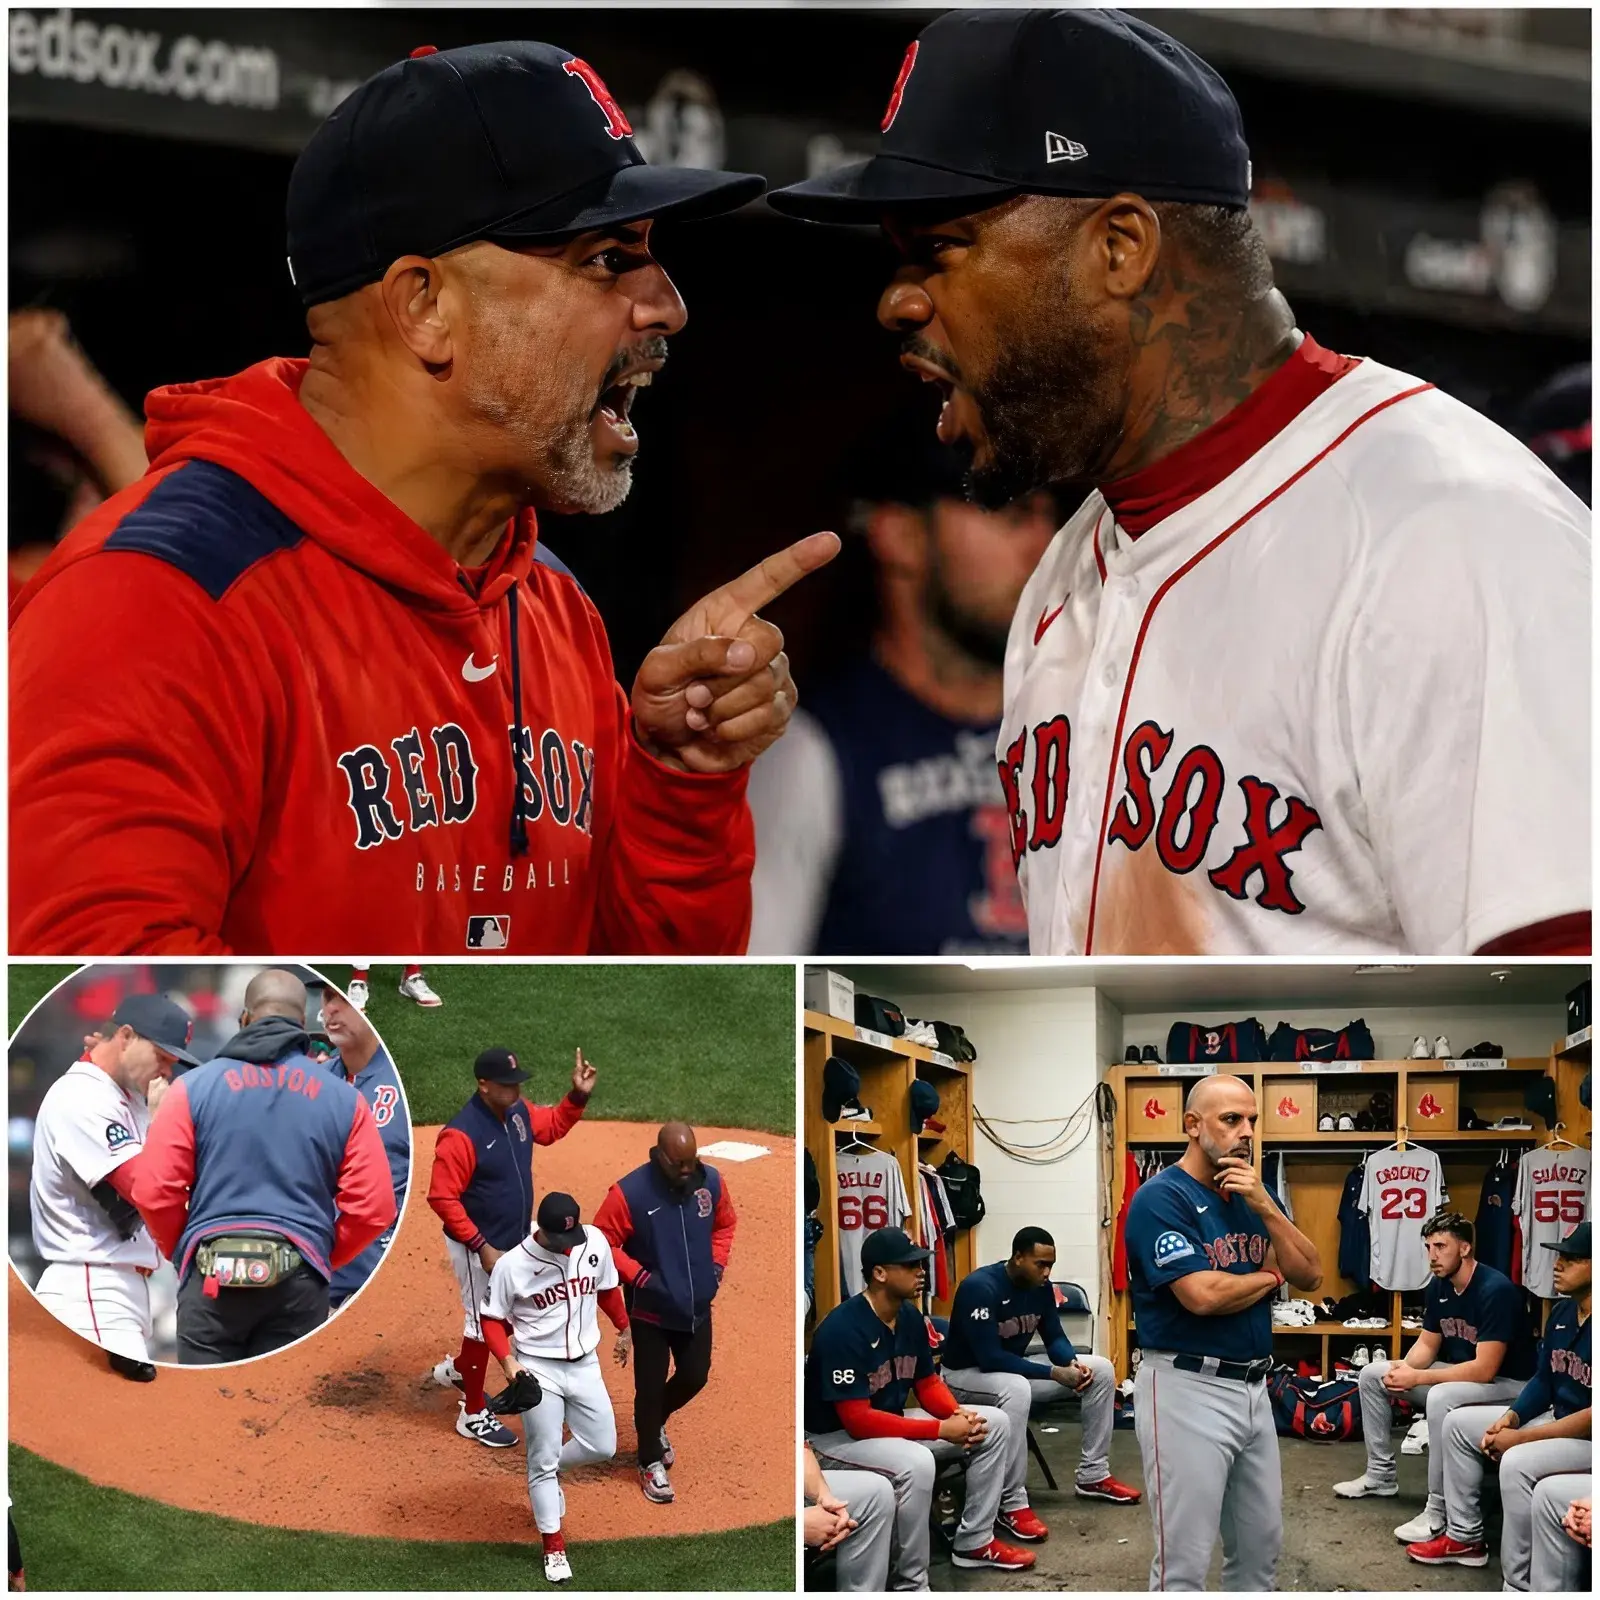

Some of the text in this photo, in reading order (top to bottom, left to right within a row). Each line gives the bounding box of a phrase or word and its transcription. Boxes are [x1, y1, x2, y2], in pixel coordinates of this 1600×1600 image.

[338, 722, 595, 850] RED SOX
[998, 714, 1071, 874] ED
[1107, 720, 1324, 915] SOX
[416, 858, 570, 893] BASEBALL
[223, 1062, 323, 1101] BOSTON
[373, 1085, 399, 1128] B
[838, 1194, 888, 1231] 66
[1381, 1187, 1427, 1220] 23
[1534, 1190, 1585, 1223] 55
[1203, 1232, 1268, 1270] BOSTO
